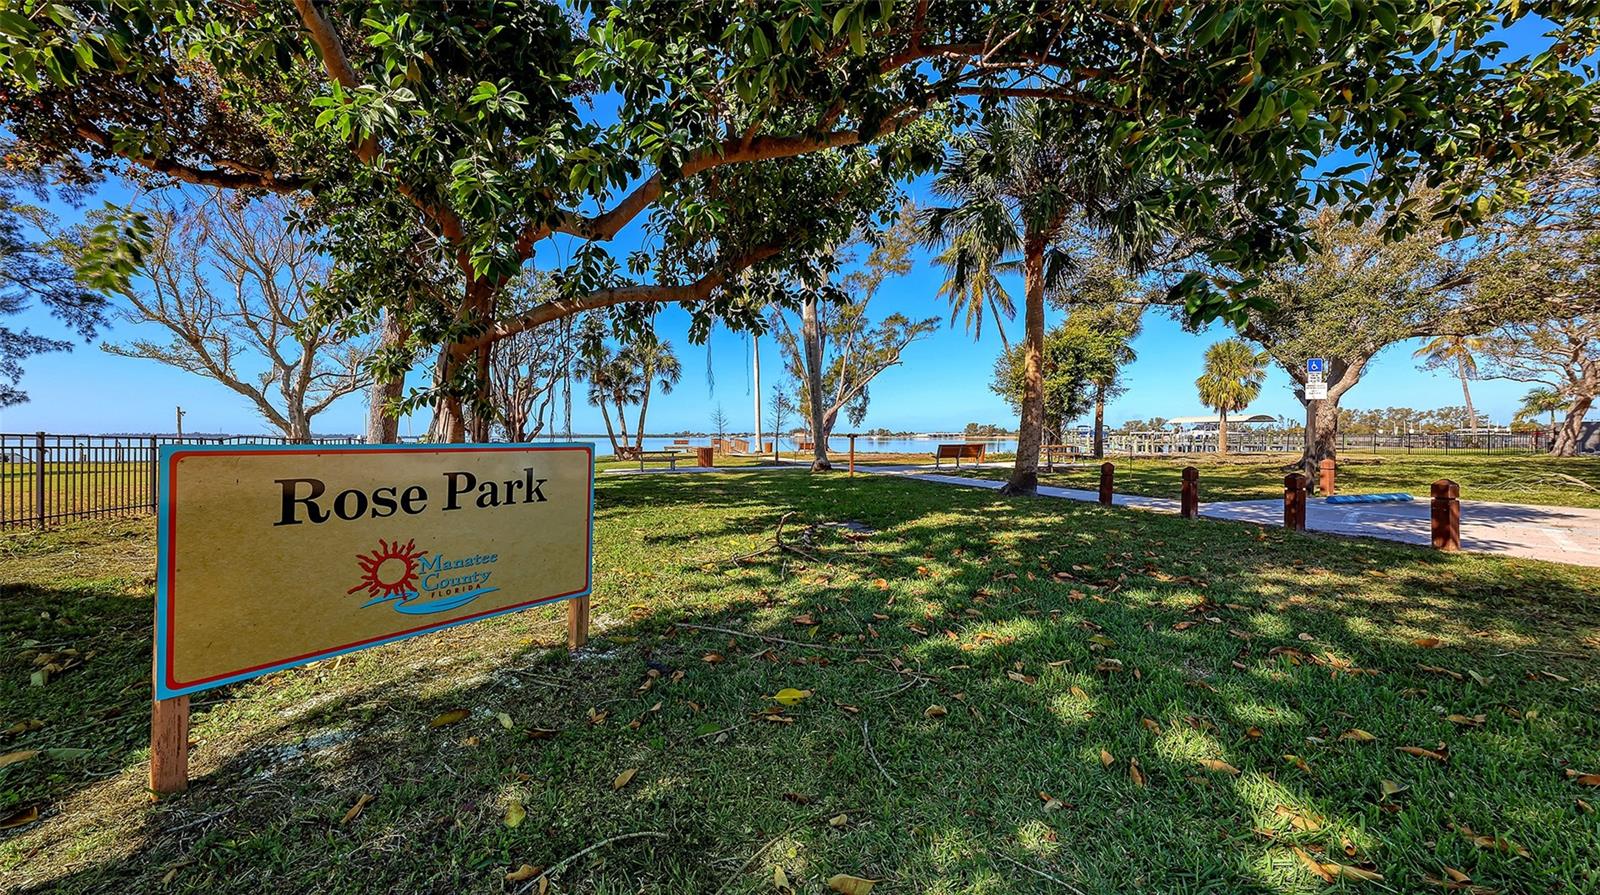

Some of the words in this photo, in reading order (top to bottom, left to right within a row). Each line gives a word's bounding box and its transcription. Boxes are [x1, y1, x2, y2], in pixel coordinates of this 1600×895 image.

[273, 477, 428, 526] Rose
[441, 467, 548, 511] Park
[418, 552, 498, 575] Manatee
[421, 570, 492, 592] County
[431, 583, 481, 598] FLORIDA
